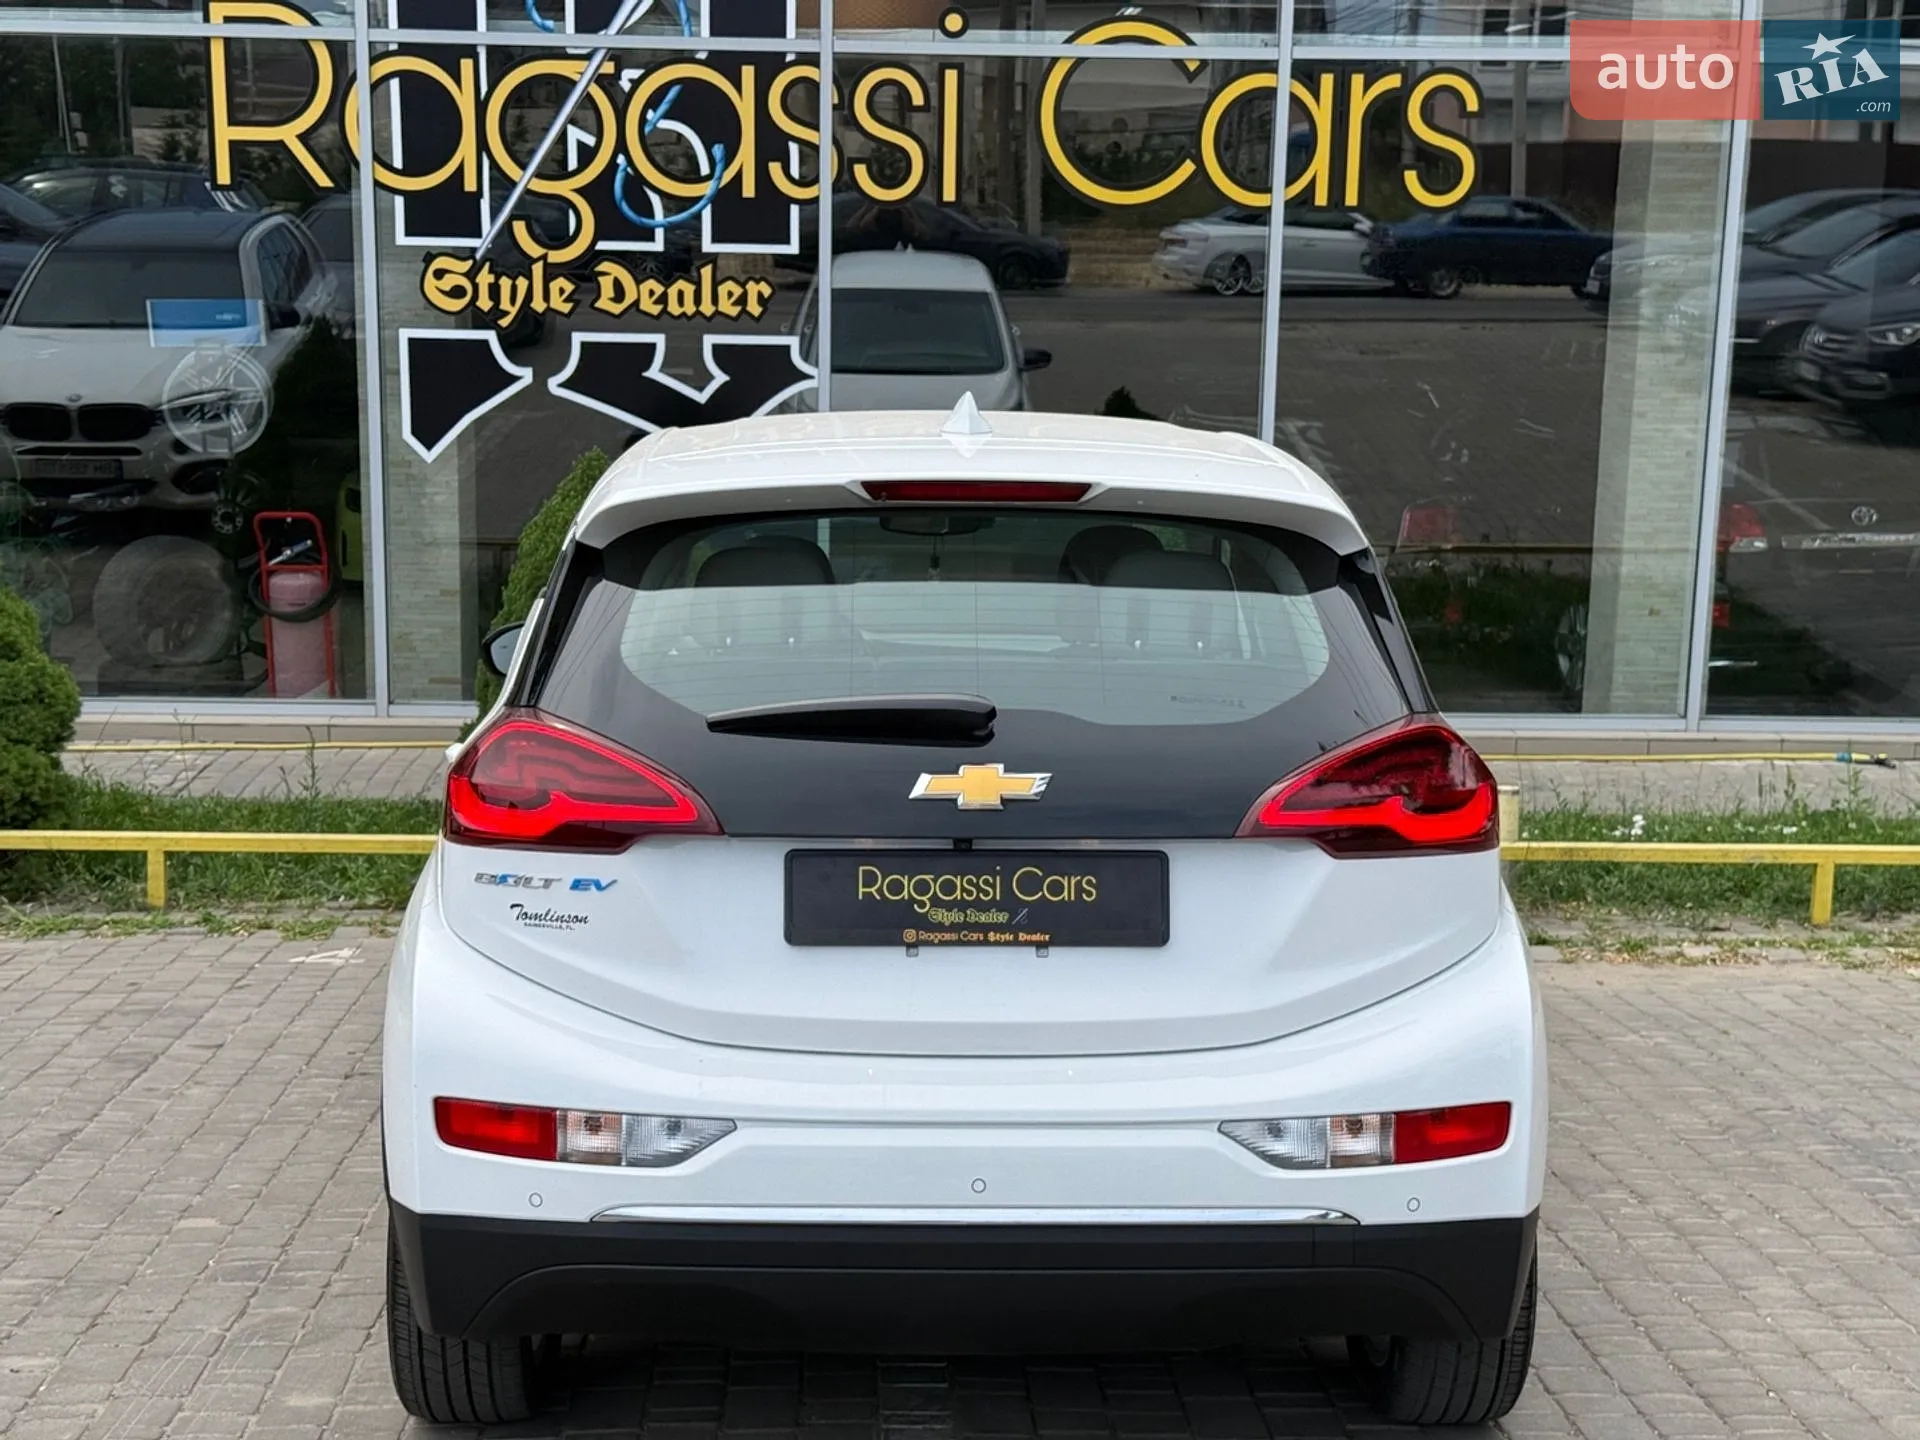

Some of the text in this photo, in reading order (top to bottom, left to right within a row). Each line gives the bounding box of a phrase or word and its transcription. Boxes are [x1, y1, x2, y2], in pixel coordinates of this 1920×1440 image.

[208, 1, 1481, 263] Ragassi Cars
[423, 255, 773, 328] Style Dealer
[474, 872, 618, 892] BOLT EV
[857, 865, 1097, 913] Ragassi Cars
[509, 903, 590, 924] Tomlinson
[928, 907, 1010, 926] Style Dealer
[918, 930, 958, 943] Ragassi
[960, 930, 984, 941] Cars
